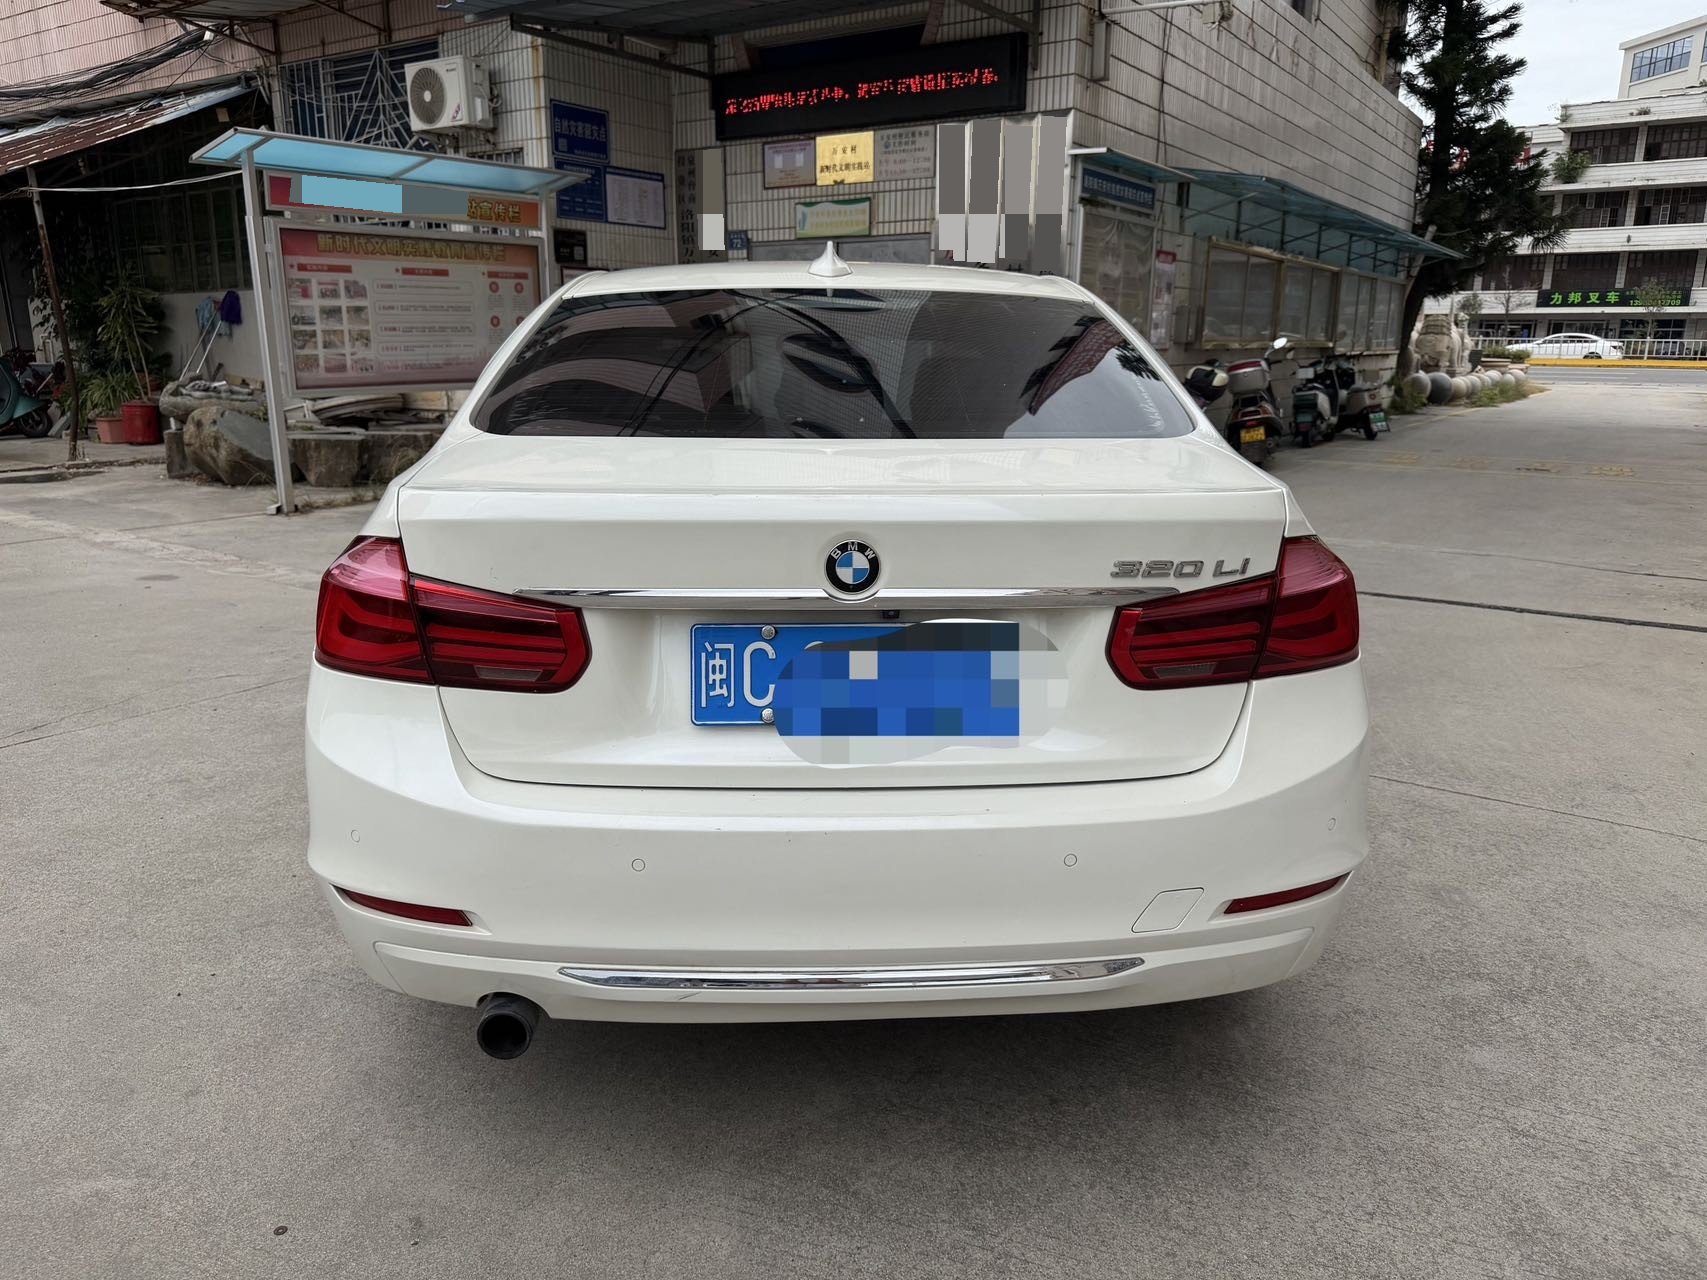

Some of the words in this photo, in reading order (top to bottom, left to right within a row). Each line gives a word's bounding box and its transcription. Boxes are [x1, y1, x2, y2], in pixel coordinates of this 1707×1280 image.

[1550, 291, 1620, 305] 力邦叉车
[830, 541, 876, 560] BMW
[1110, 560, 1204, 578] 320
